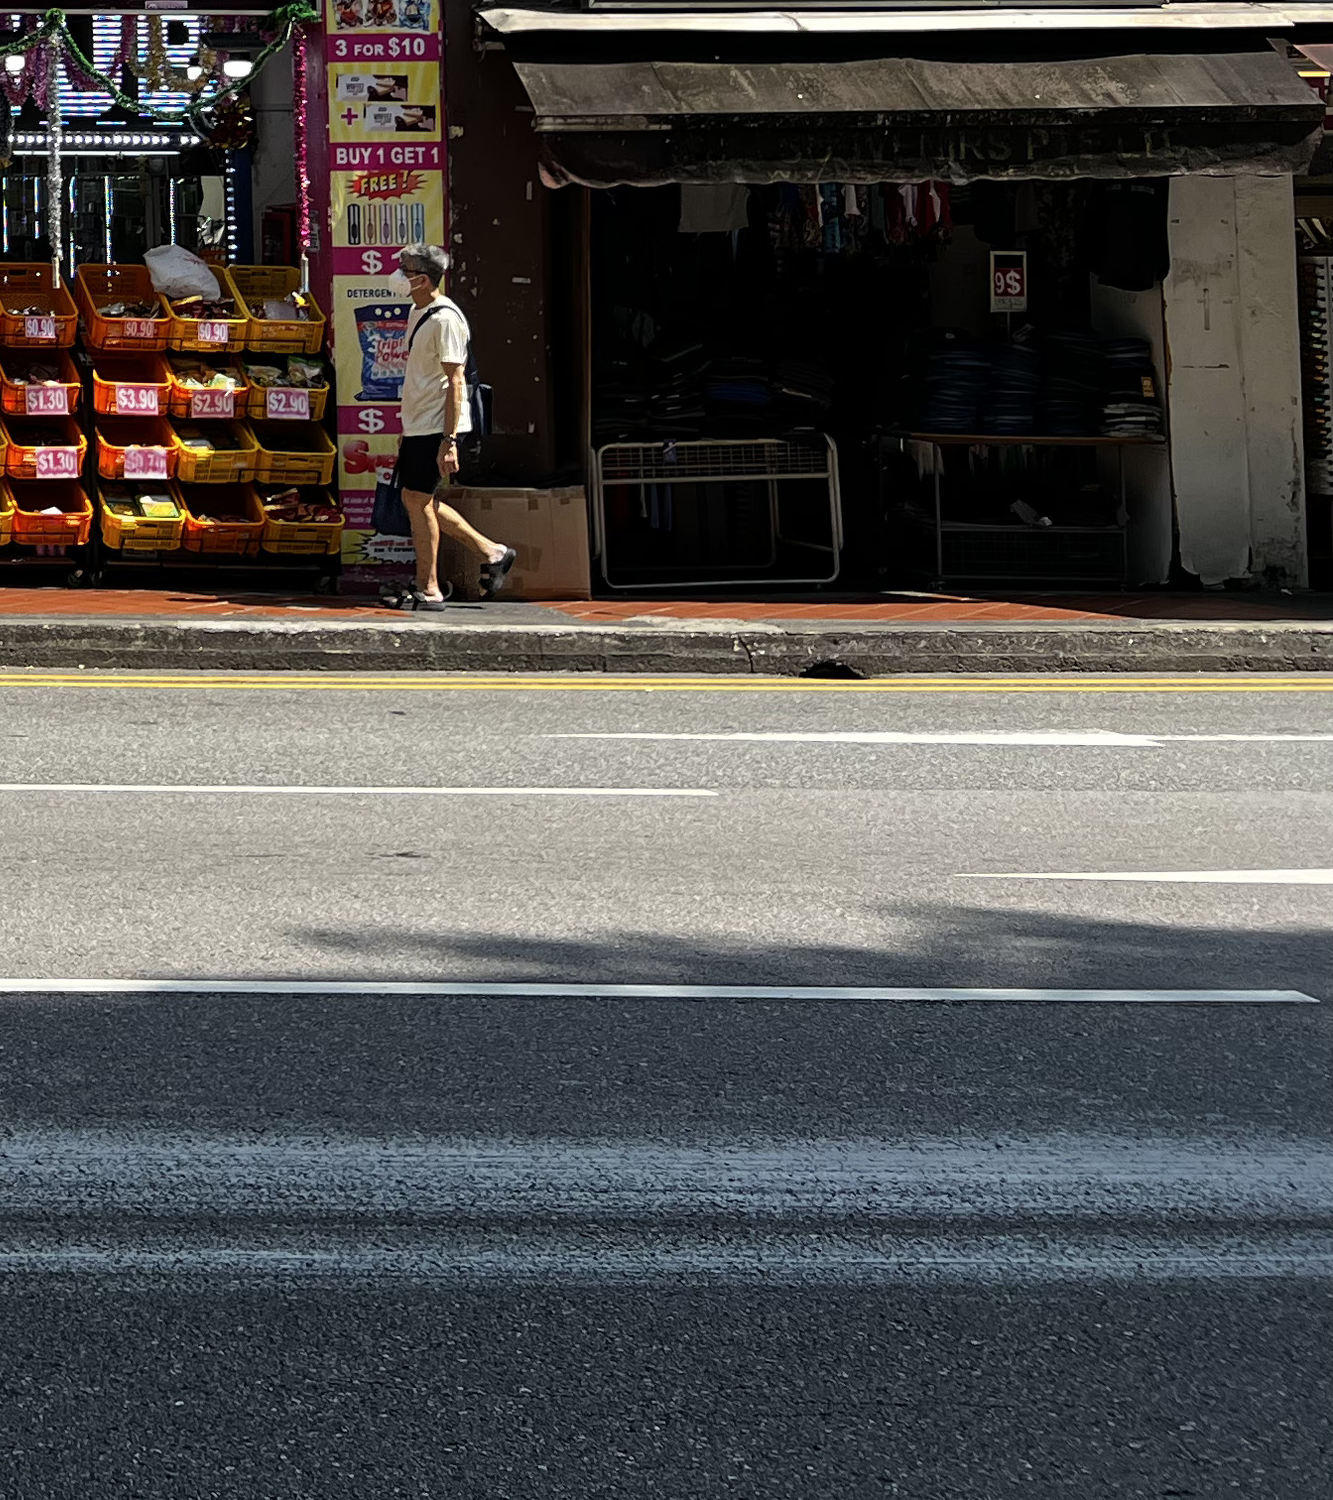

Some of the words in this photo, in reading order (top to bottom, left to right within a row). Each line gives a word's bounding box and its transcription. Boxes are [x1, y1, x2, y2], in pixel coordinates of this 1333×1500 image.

[335, 40, 347, 56] 3
[354, 44, 384, 57] FOR
[388, 37, 426, 57] $10
[336, 148, 372, 165] BUY
[376, 148, 386, 164] 1
[390, 147, 426, 164] GET
[430, 147, 439, 163] 1
[995, 269, 1022, 295] 9$
[26, 319, 54, 337] $0.90
[126, 321, 153, 337] $0.90
[199, 323, 228, 340] $0.90
[28, 390, 64, 409] $1.30
[118, 390, 156, 409] $3.90
[194, 394, 232, 413] $2.90
[269, 393, 306, 413] $2.90
[38, 453, 74, 471] $1.30
